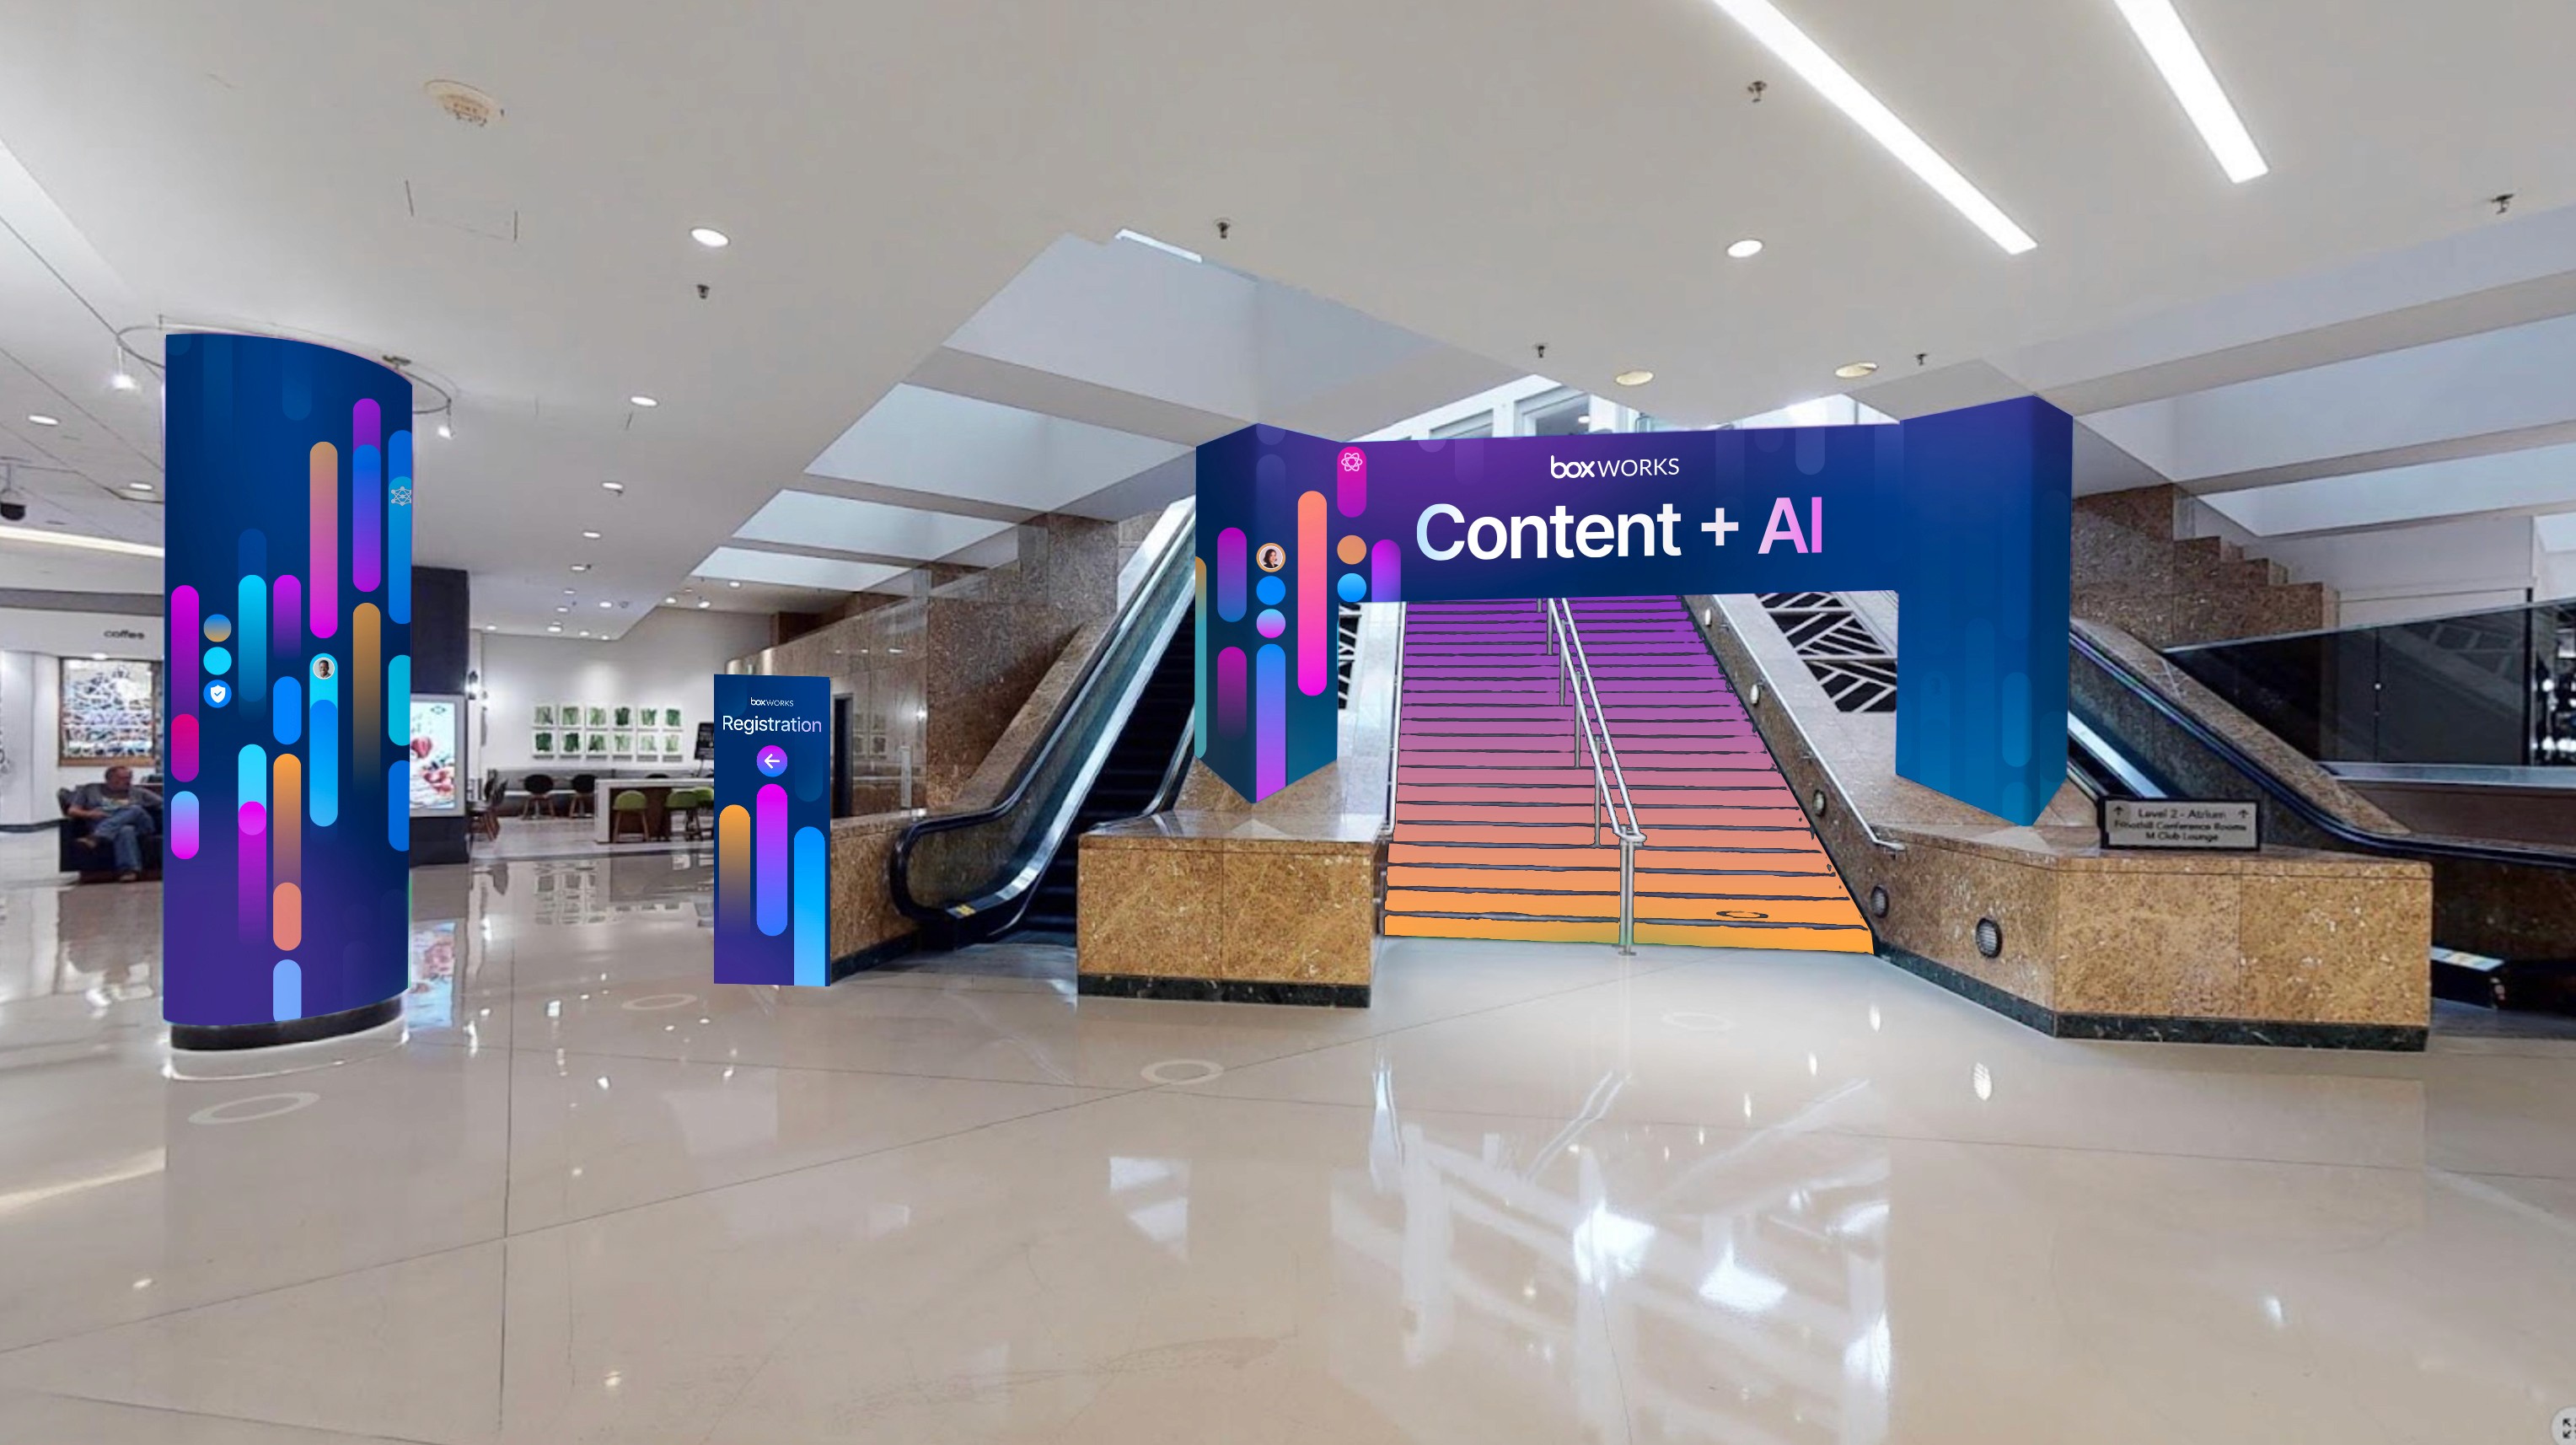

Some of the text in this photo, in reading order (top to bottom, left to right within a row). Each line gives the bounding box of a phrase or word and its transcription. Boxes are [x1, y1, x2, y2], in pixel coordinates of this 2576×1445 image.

[1550, 454, 1680, 479] boxWORKS
[1416, 497, 1822, 561] Content + AI
[750, 696, 794, 707] boxWORKS
[722, 715, 822, 735] Registration
[2138, 808, 2167, 819] Level
[2171, 808, 2178, 819] 2
[2187, 809, 2226, 819] Atrium
[2156, 821, 2211, 830] Conference
[2214, 823, 2246, 831] Rooms
[2157, 831, 2181, 841] Club
[2183, 833, 2219, 842] Lounge
